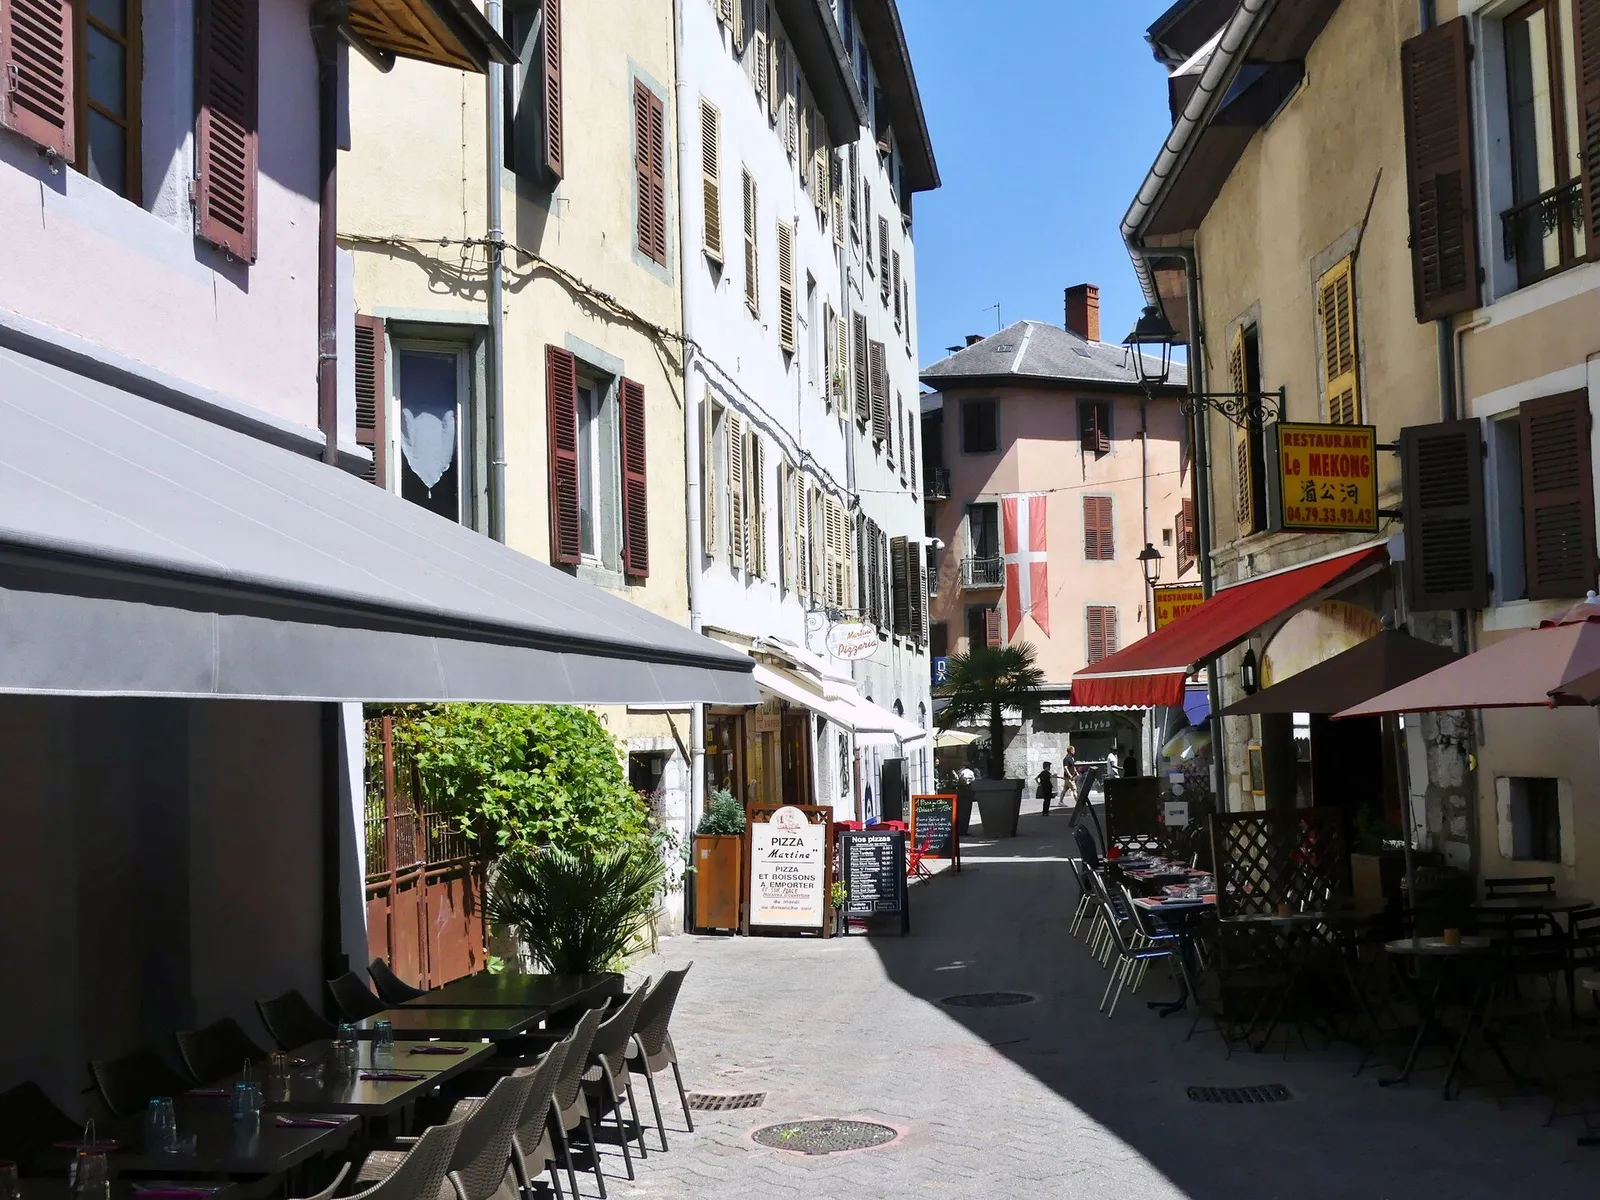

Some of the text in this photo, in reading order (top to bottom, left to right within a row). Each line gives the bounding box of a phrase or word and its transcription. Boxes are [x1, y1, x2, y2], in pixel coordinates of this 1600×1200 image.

[1283, 432, 1369, 449] RESTAURANT
[1284, 452, 1370, 478] Le MEKONG
[1287, 506, 1371, 524] 04.79.33.93.43
[1157, 592, 1203, 602] RESTAURAN
[847, 629, 872, 640] Martine
[837, 640, 877, 658] Pizzeria
[771, 837, 804, 847] PIZZA
